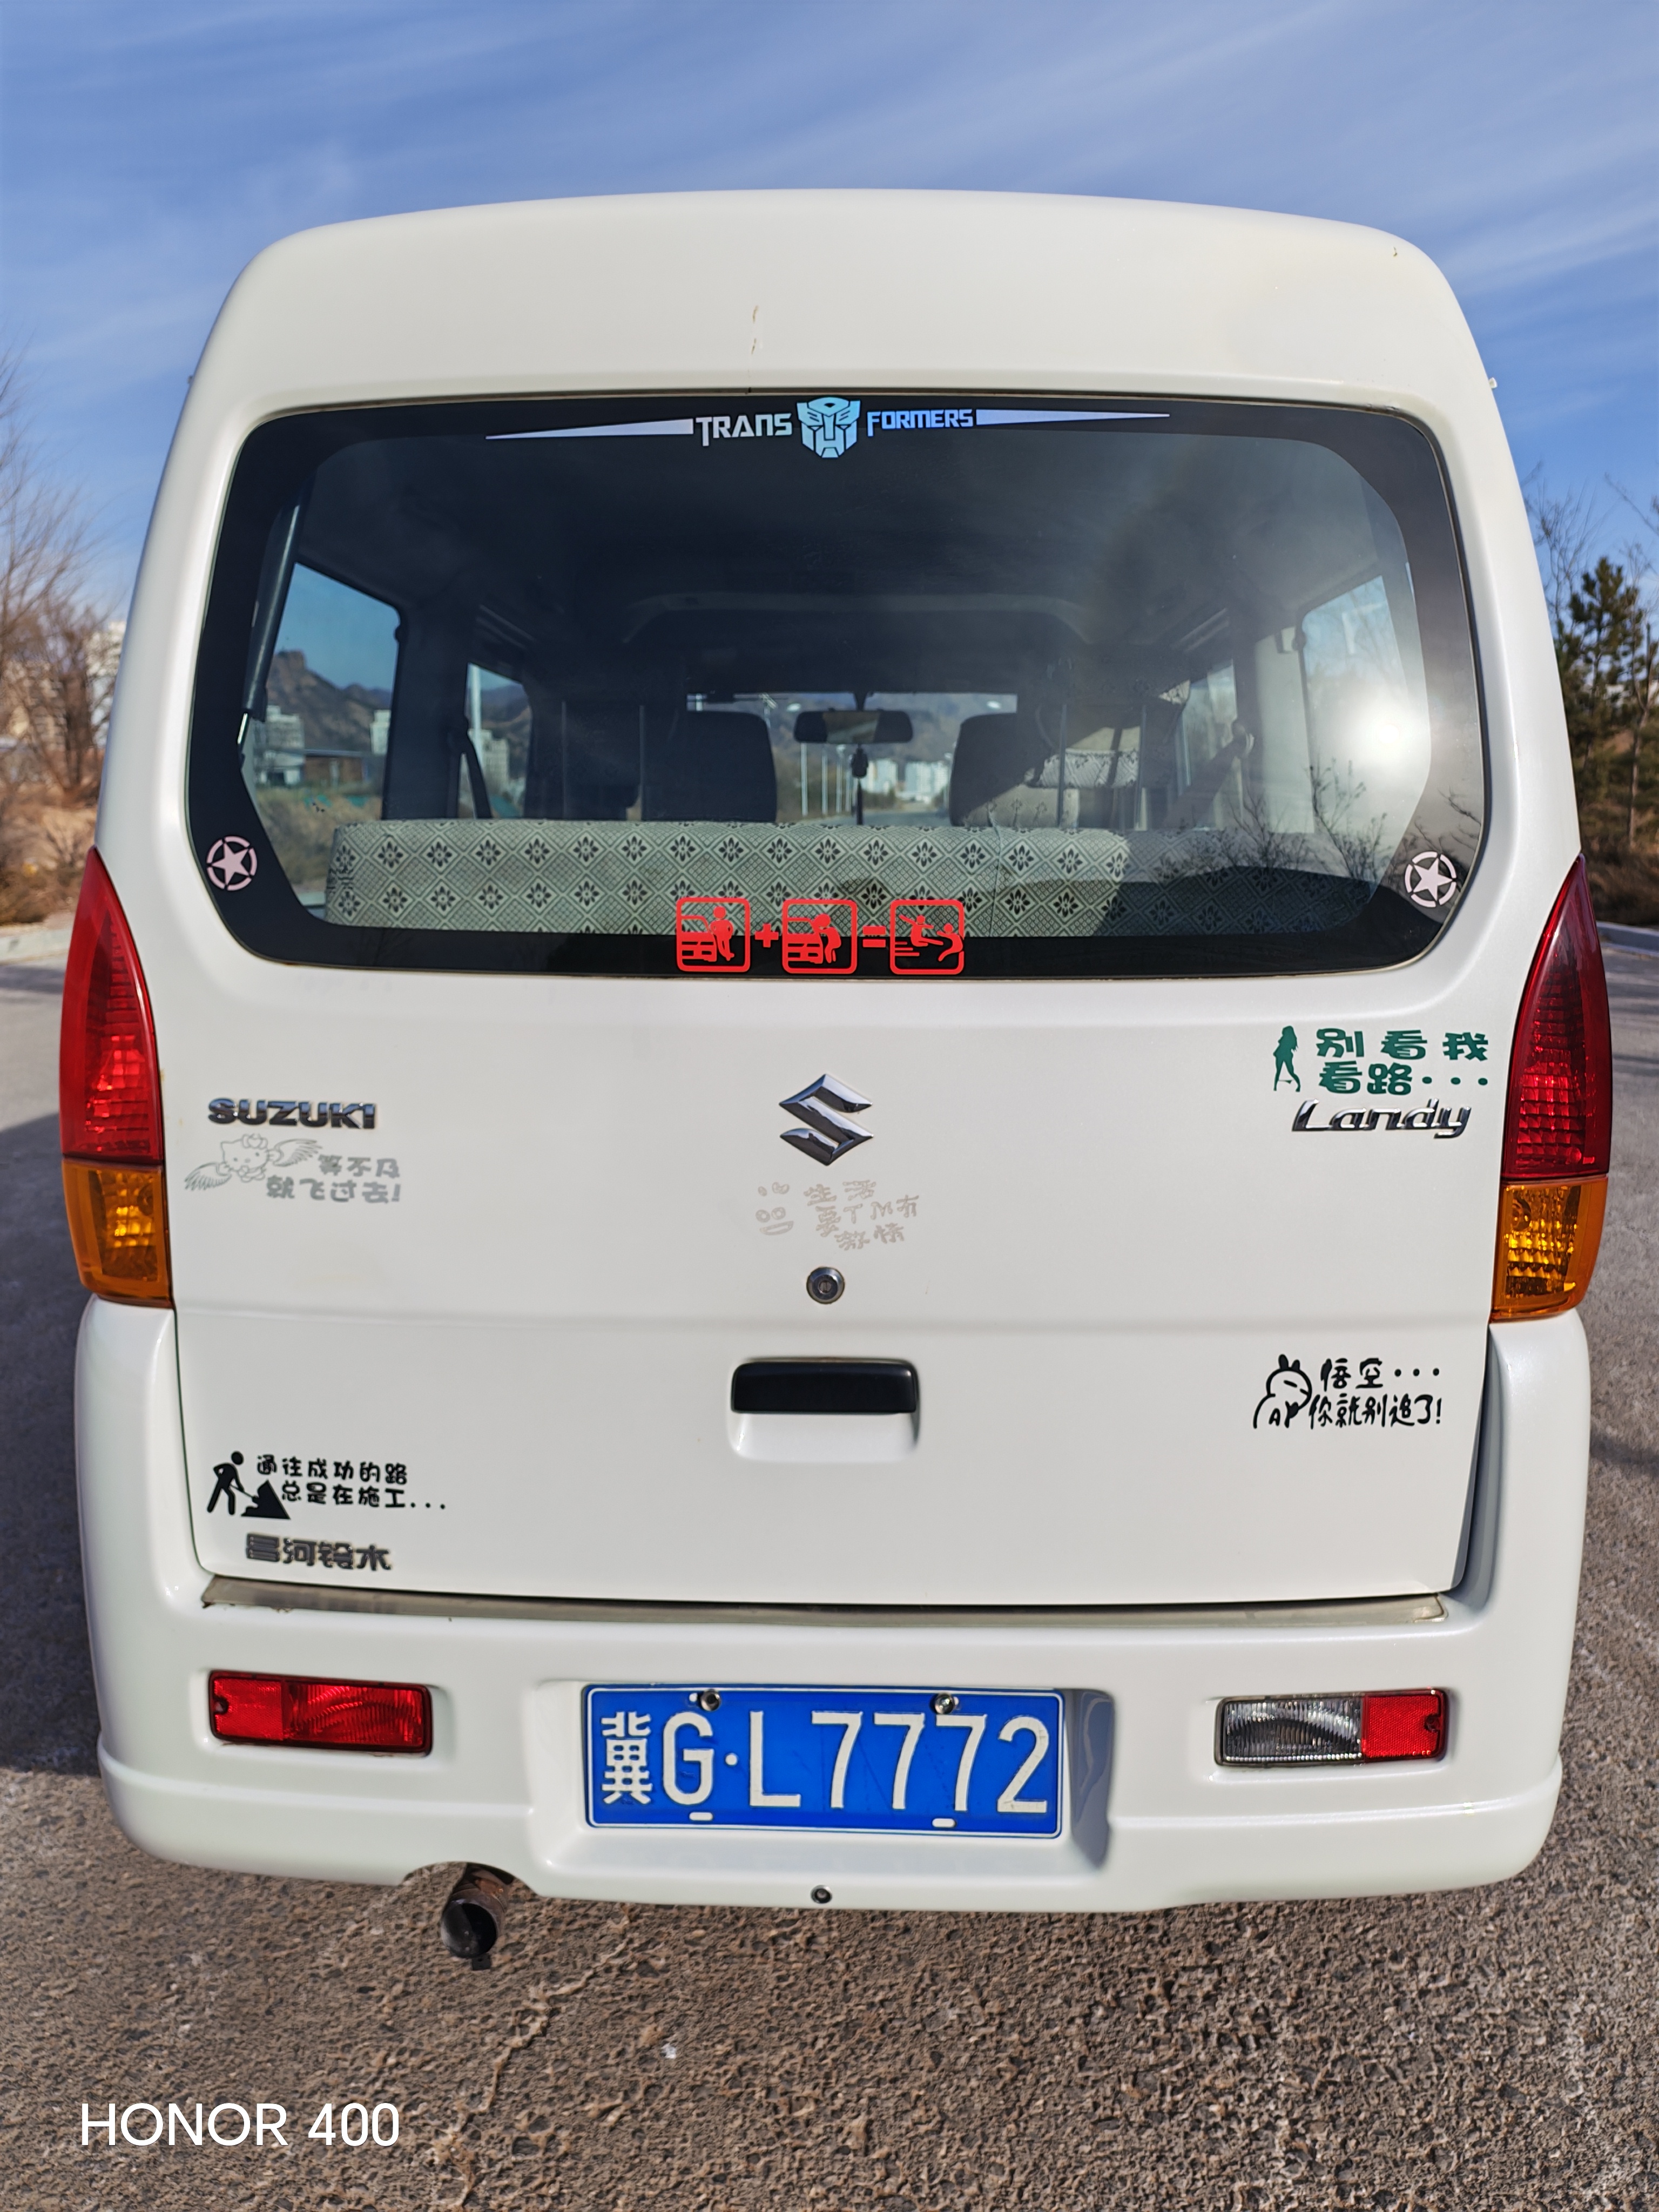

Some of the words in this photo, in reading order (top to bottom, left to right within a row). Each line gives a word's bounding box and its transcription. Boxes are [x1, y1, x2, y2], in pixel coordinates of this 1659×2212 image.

[696, 413, 792, 447] TRANS
[867, 409, 974, 437] FORMERS
[1316, 1027, 1489, 1061] 别看我
[208, 1097, 375, 1129] SUZUKI
[1291, 1098, 1472, 1139] Landy
[803, 1179, 876, 1206] 生活
[256, 1454, 408, 1485] 通往成功的路
[246, 1533, 392, 1572] 昌河铃木
